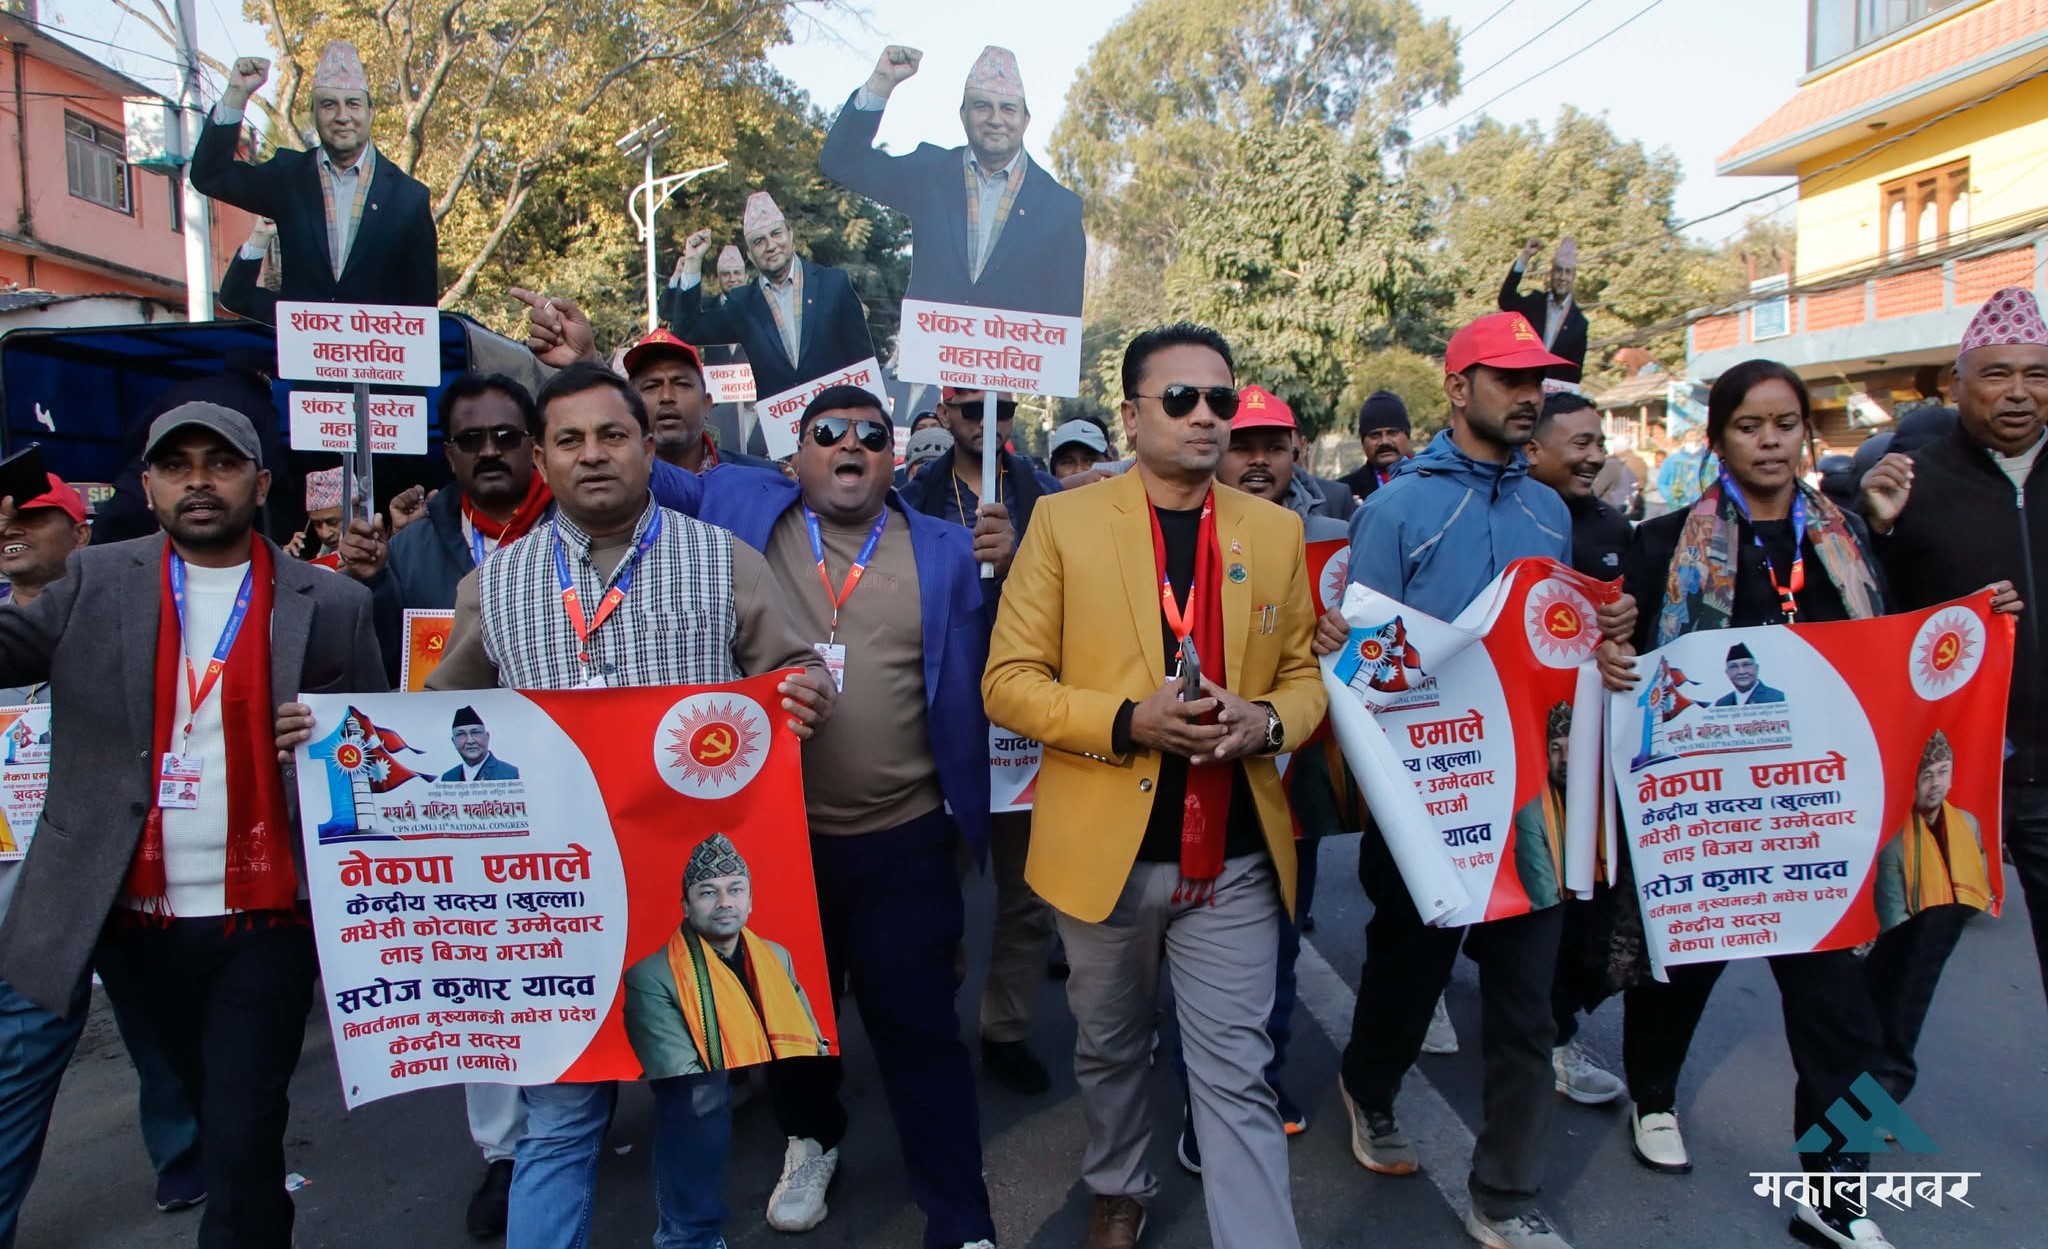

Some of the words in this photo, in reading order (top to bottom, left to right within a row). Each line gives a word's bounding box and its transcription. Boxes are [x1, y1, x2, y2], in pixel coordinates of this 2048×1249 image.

[291, 310, 344, 333] शंकर
[350, 310, 426, 335] पोखरेल
[917, 310, 976, 337] शंकर
[984, 314, 1067, 345] पोखरेल
[313, 339, 406, 363] महासचिव
[939, 345, 1043, 373] महासचिव
[316, 366, 347, 378] पदका
[352, 366, 405, 381] उम्मेदवार
[710, 367, 736, 380] शंकर
[940, 370, 976, 385] पदका
[980, 373, 1040, 391] उम्मेदवार
[302, 398, 346, 415] शंकर
[768, 392, 809, 419] शंकर
[320, 420, 399, 437] महाचिव
[322, 440, 349, 448] पदका
[1407, 708, 1484, 749] एमाले
[1426, 750, 1482, 772] (खुल्ला)
[3, 772, 30, 781] नेकपा
[1428, 770, 1495, 794] उम्मेदवार
[1638, 768, 1723, 804] नेकपा
[1749, 750, 1847, 788] एमाले
[1641, 803, 1698, 827] केन्द्रीय
[1705, 797, 1764, 814] सदस्य
[1770, 790, 1841, 809] (खुल्ला)
[393, 825, 409, 833] CPN
[411, 824, 437, 832] (UML)
[489, 821, 529, 829] CONGRESS
[1442, 822, 1492, 847] यादव
[1687, 817, 1763, 837] कोटाबाट
[1770, 810, 1857, 830] उम्मेदवार
[1469, 852, 1494, 869] प्रदेश
[1662, 844, 1696, 865] लाइ
[1702, 839, 1753, 858] बिजय
[338, 850, 453, 887] नेकपा
[481, 843, 592, 883] एमाले
[1701, 866, 1774, 892] कुमार
[1783, 860, 1849, 881] यादव
[346, 891, 425, 915] केन्द्रीय
[433, 893, 497, 912] सदस्य
[506, 891, 585, 912] (खुल्ला)
[1698, 892, 1767, 912] मुख्यमन्त्री
[1814, 887, 1848, 902] प्रदेश
[413, 915, 498, 937] कोटाबाट
[505, 912, 604, 934] उम्मेदवार
[1668, 916, 1725, 935] केन्द्रीय
[1731, 911, 1781, 929] सदस्य
[380, 945, 424, 965] लाइ
[432, 940, 488, 962] बिजय
[1669, 935, 1714, 954] नेकपा
[1721, 928, 1778, 947] (एमाले)
[336, 977, 422, 1014] सरोज
[432, 978, 511, 1004] कुमार
[521, 975, 596, 999] यादव
[343, 1013, 420, 1041] निवर्तमान
[426, 1009, 505, 1027] मुख्यमन्त्री
[558, 1005, 597, 1022] प्रदेश
[388, 1031, 461, 1055] केन्द्रीय
[468, 1032, 521, 1050] सदस्य
[390, 1056, 449, 1079] नेकपा
[457, 1054, 518, 1072] (एमाले)
